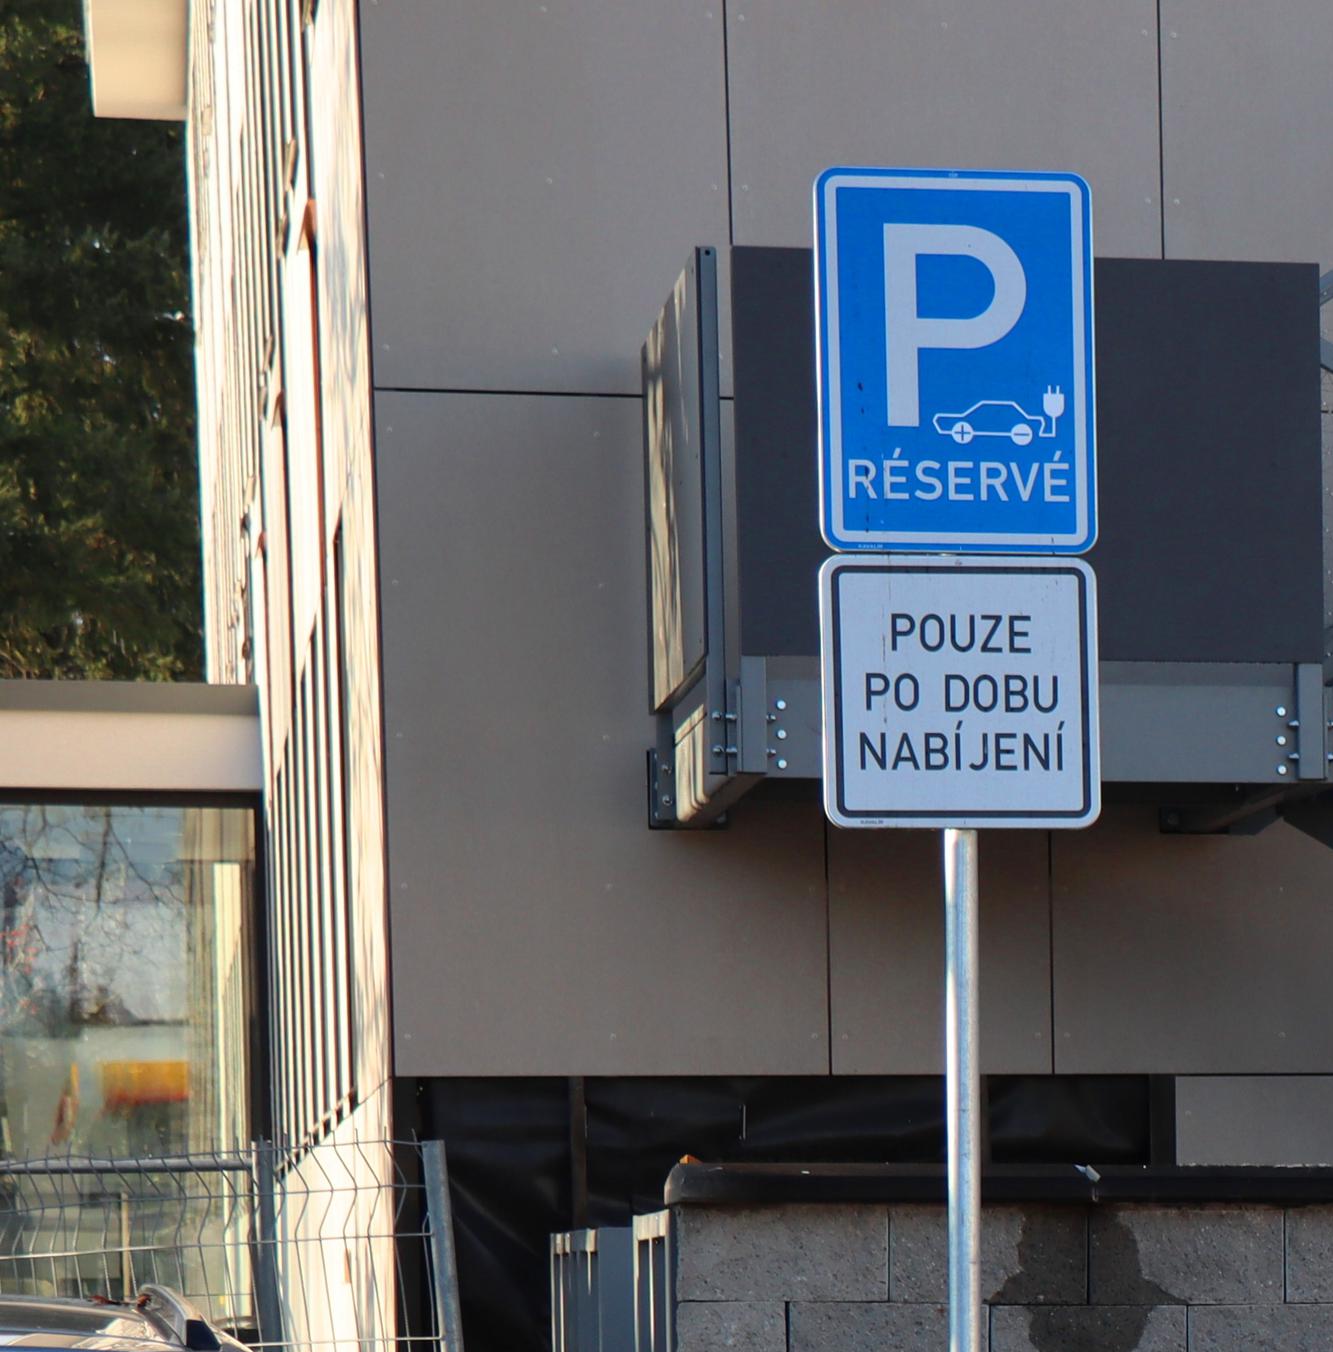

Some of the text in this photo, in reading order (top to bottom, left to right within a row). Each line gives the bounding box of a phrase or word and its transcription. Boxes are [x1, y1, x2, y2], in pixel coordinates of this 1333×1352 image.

[883, 223, 1027, 427] P
[848, 447, 1070, 503] RÉSERVÉ
[890, 612, 1032, 654] POUZE
[865, 672, 1059, 714] PO DOBU
[859, 719, 1065, 771] NABÍJENÍ
